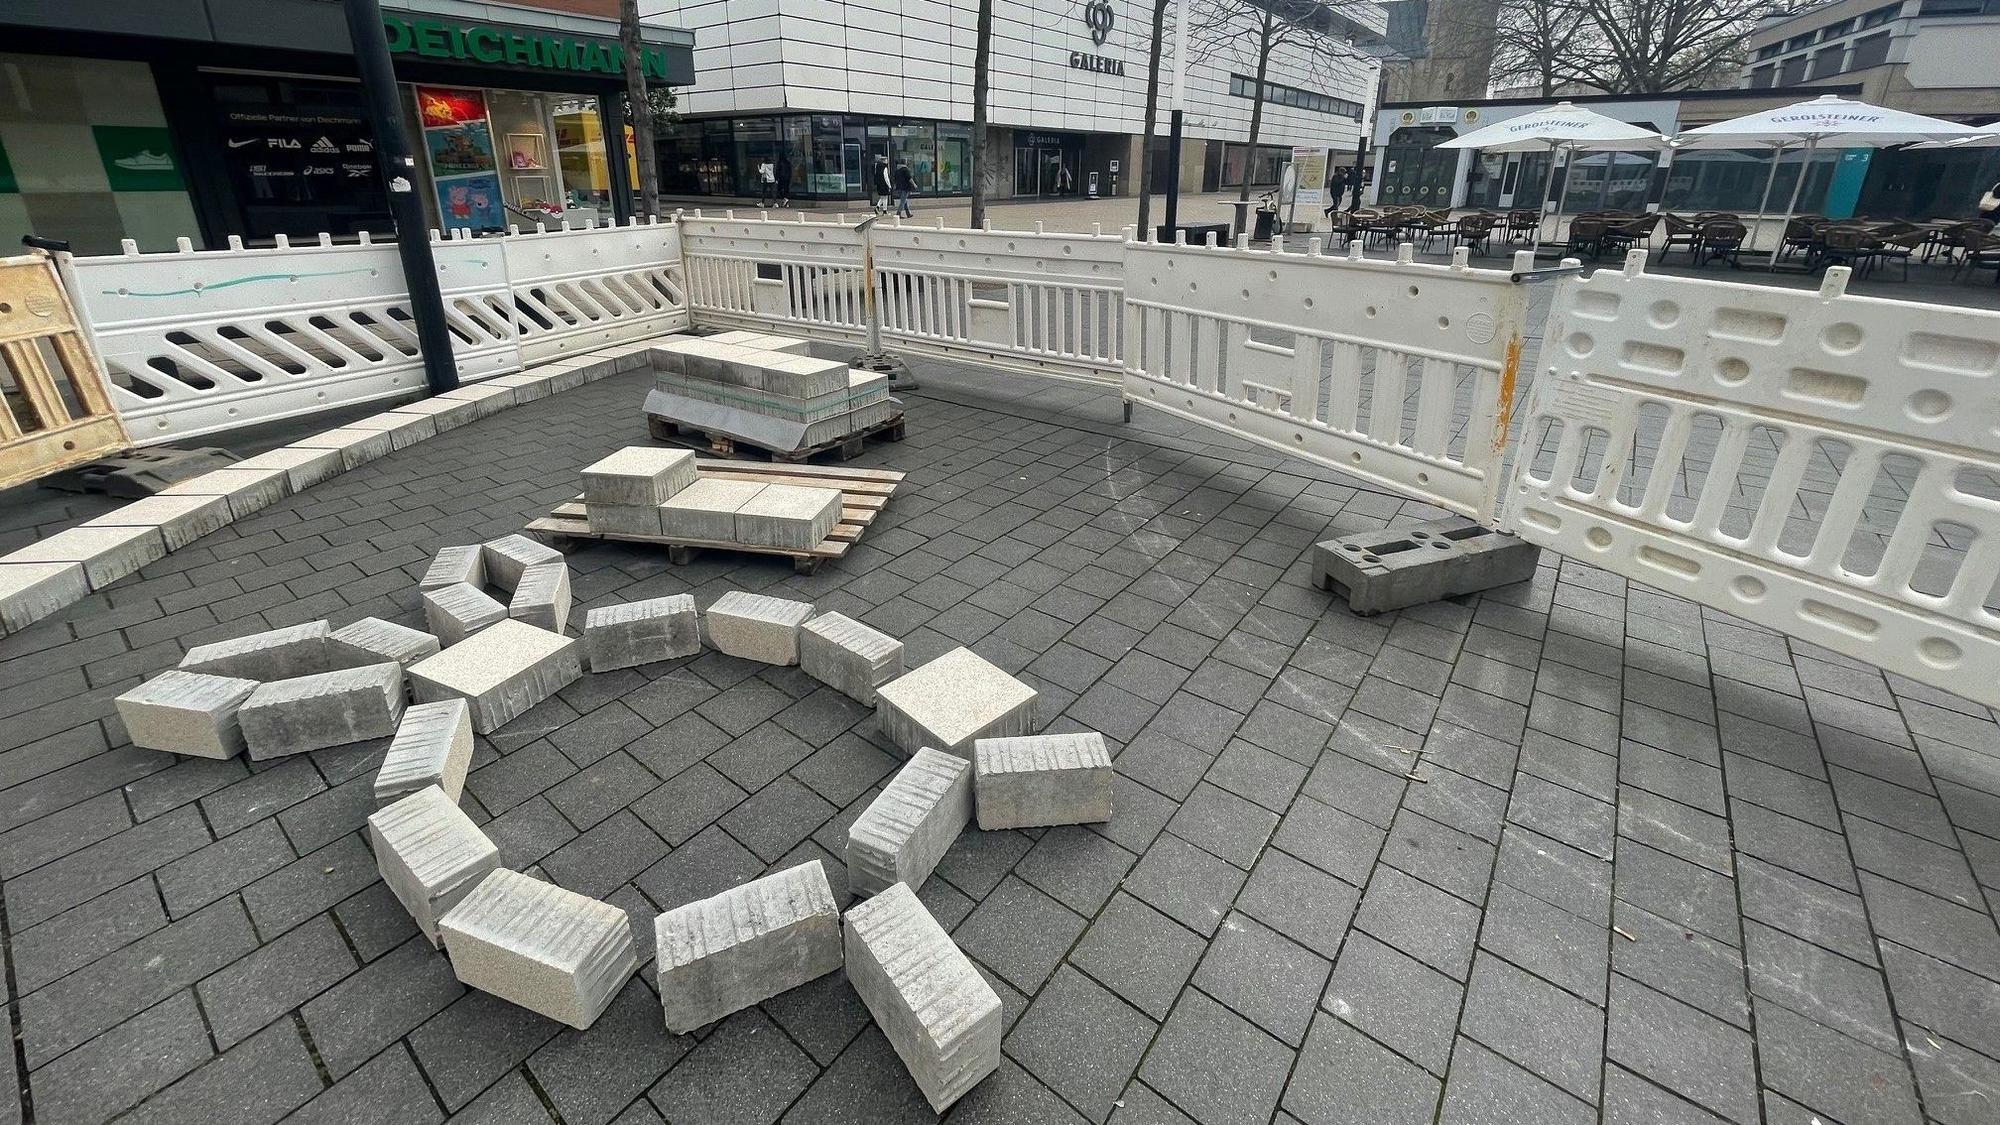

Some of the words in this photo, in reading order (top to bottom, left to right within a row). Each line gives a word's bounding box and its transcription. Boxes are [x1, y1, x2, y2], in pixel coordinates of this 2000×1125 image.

[1069, 51, 1125, 77] GALERIA
[1771, 113, 1880, 123] GEROLSTEINER
[1509, 119, 1589, 132] GEROLSTEINER
[267, 138, 301, 148] FILA
[345, 144, 370, 152] PUMA
[1036, 135, 1060, 144] GALERIA
